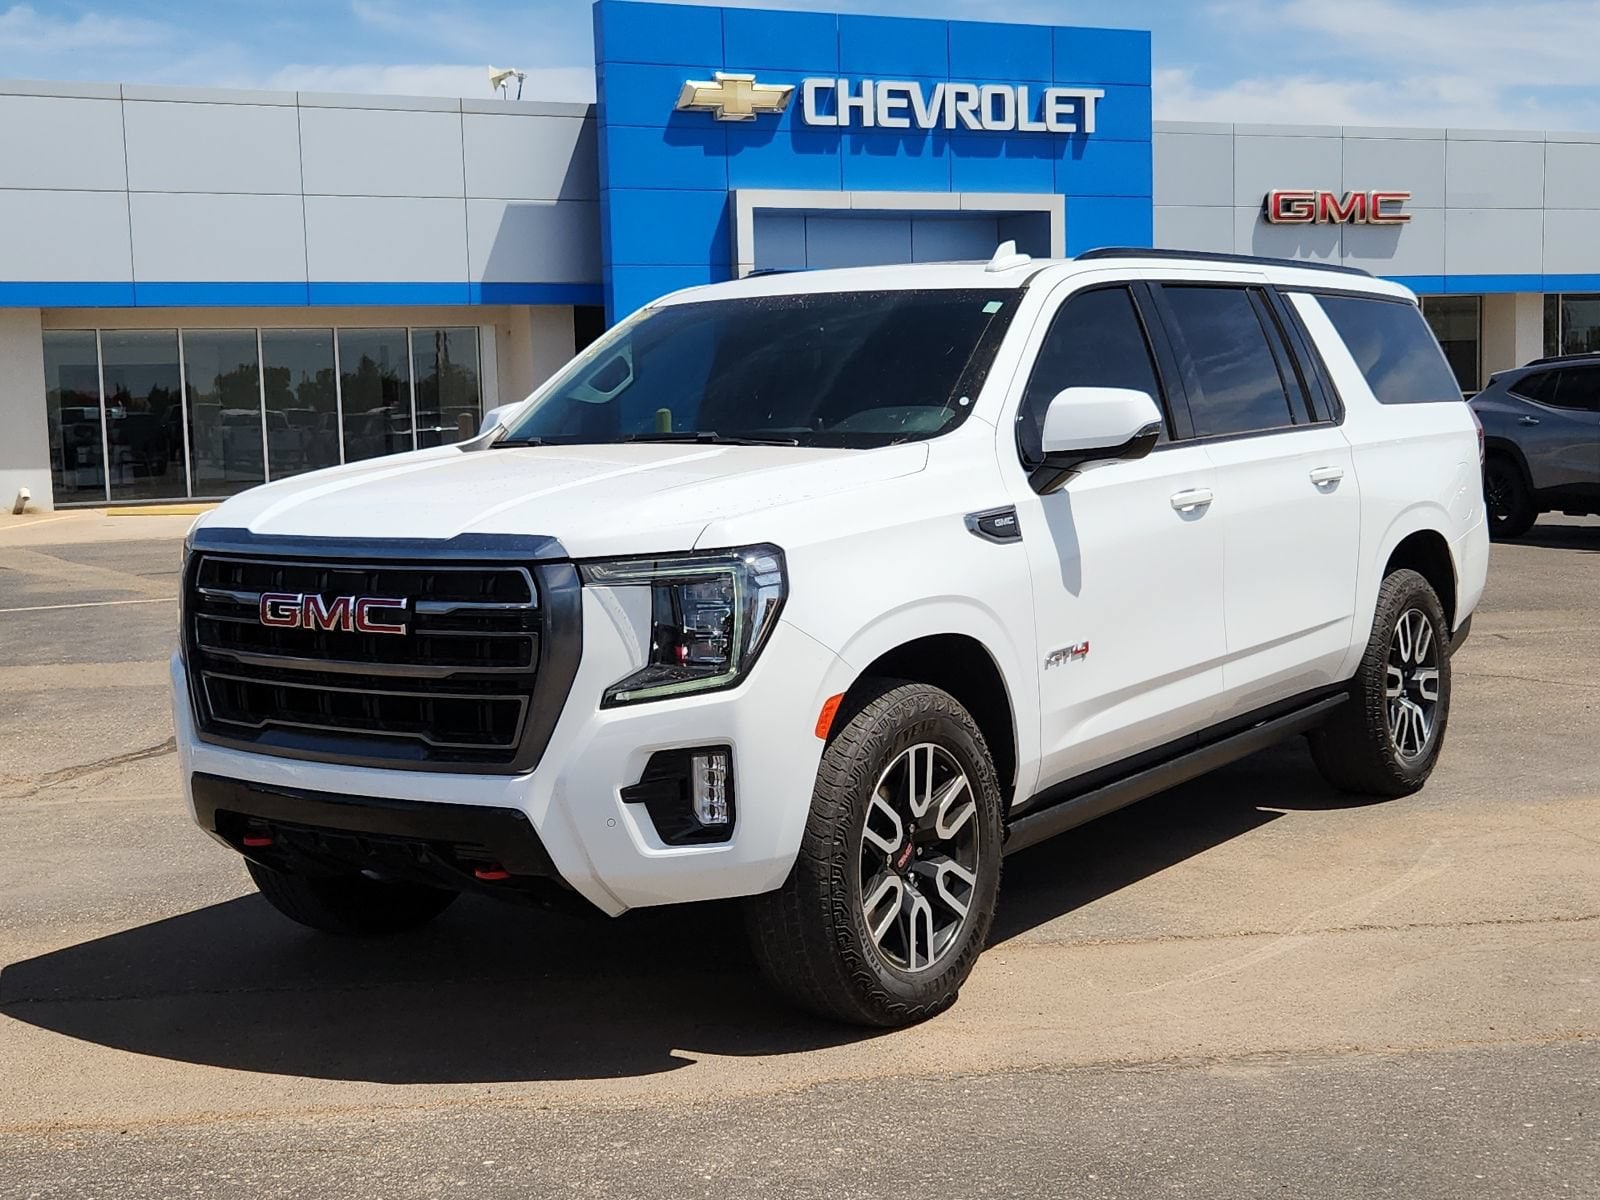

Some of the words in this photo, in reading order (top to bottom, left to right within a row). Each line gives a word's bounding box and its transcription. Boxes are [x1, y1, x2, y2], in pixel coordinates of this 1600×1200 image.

[803, 78, 1105, 133] CHEVROLET
[1268, 190, 1412, 224] GMC
[995, 517, 1014, 527] GMC
[260, 592, 407, 635] GMC
